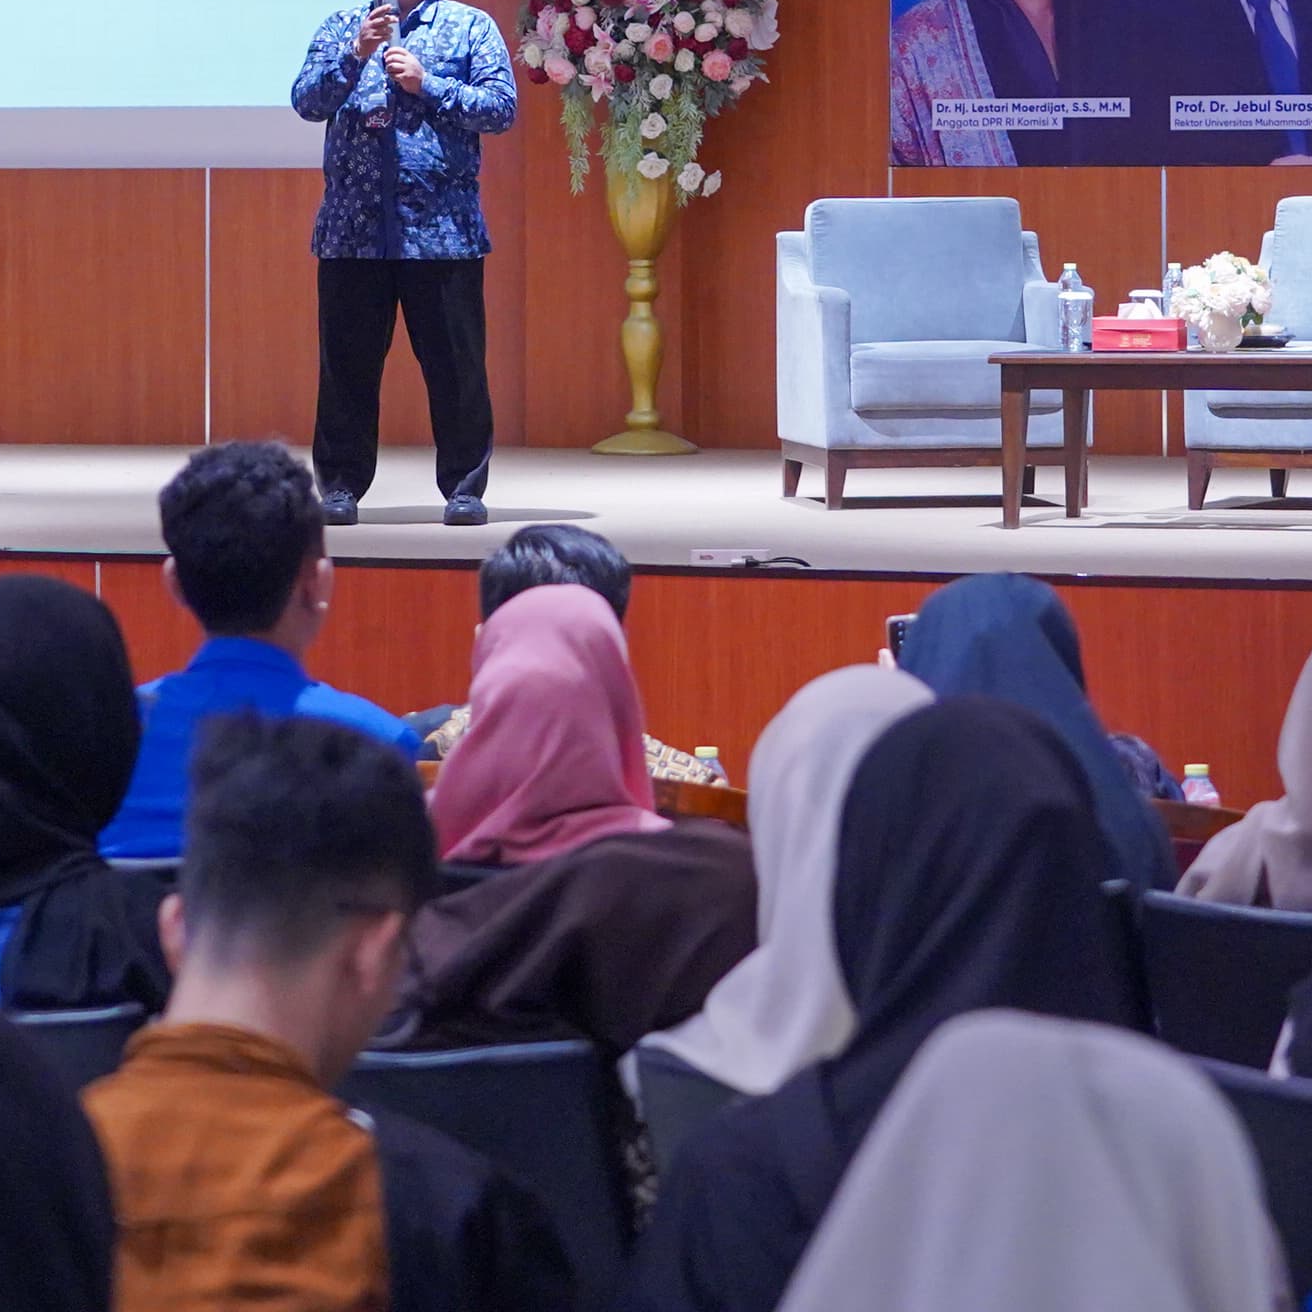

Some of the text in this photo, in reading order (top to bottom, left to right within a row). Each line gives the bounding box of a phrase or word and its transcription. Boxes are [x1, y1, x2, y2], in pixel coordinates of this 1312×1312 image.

[936, 102, 1126, 116] Dr. Hj. Lestari Moerdijat, S.S., M.M.
[1176, 100, 1206, 113] Prof.
[1210, 101, 1228, 113] Dr.
[1233, 100, 1271, 112] Jebul
[936, 118, 1058, 129] Anggota DPR RI Komisi X
[1174, 118, 1202, 127] Rektor
[1205, 118, 1252, 127] Universitas
